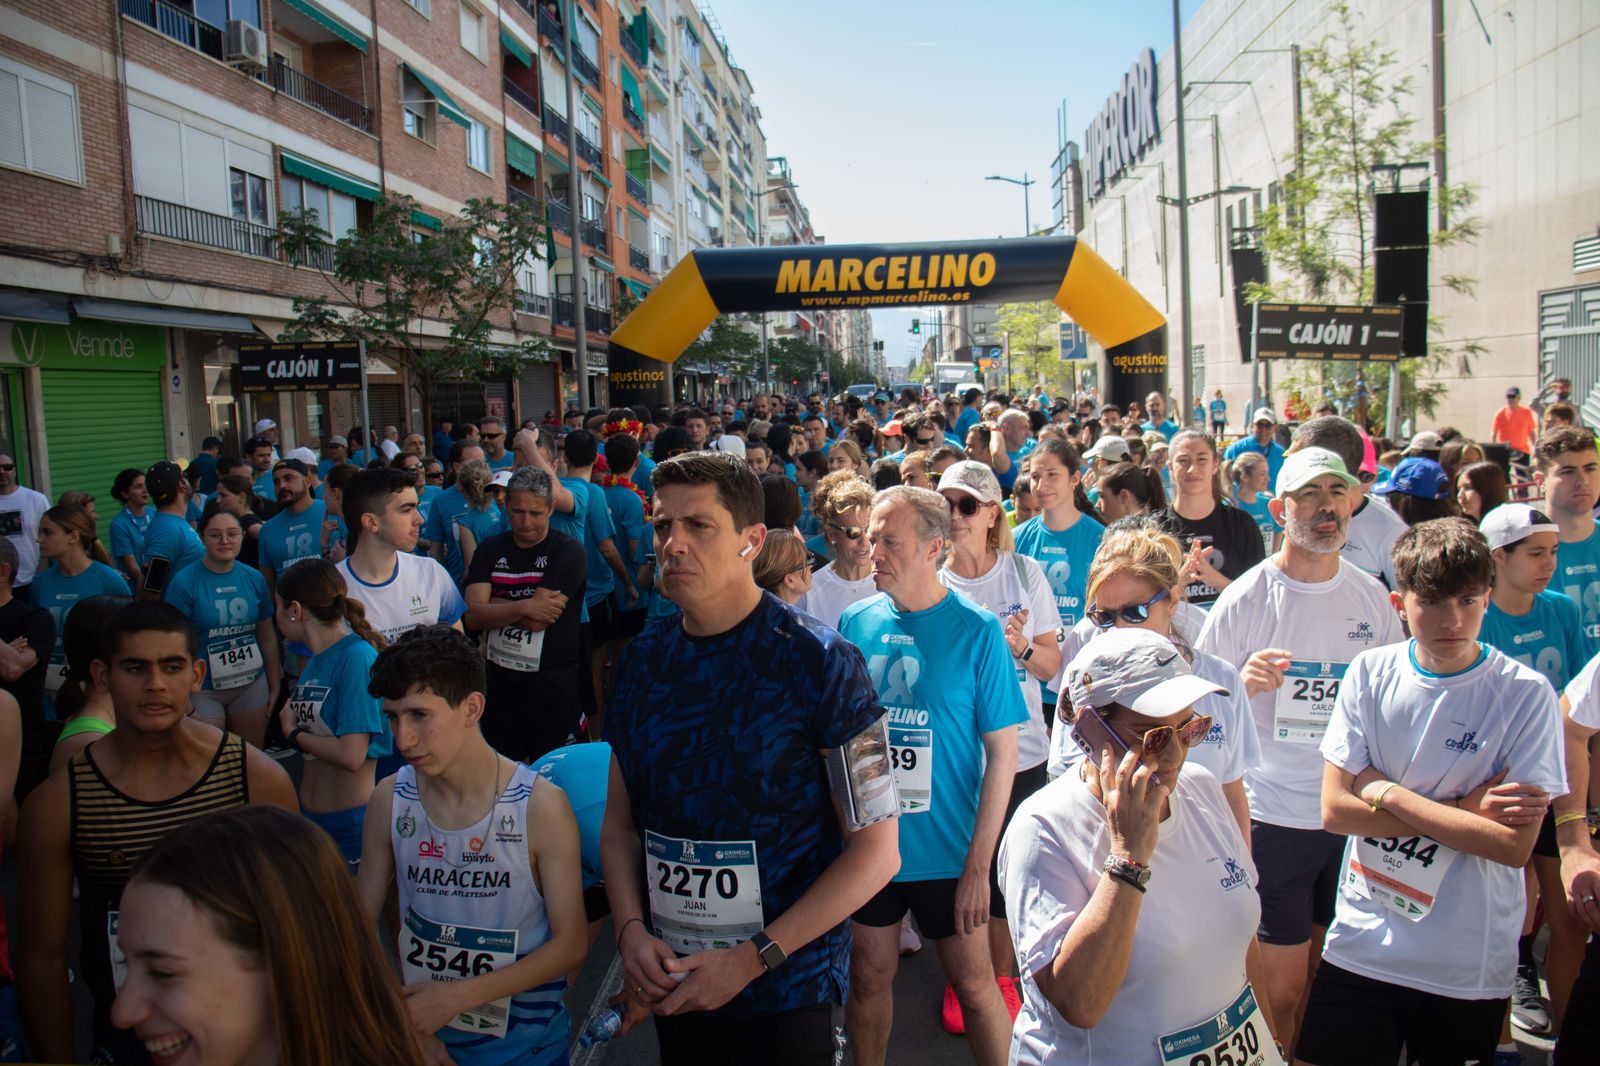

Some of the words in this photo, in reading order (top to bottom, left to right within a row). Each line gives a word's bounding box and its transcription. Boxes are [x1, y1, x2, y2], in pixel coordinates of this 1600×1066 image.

[775, 252, 997, 293] MARCELINO
[801, 291, 971, 307] www.mpmarcelino.es
[1288, 318, 1353, 345] CAJÓN
[1360, 325, 1371, 346] 1
[65, 328, 135, 358] Vennde
[266, 355, 320, 379] CAJÓN
[326, 359, 334, 377] 1
[610, 369, 665, 383] agustinos
[215, 597, 249, 625] 18
[208, 624, 255, 638] MARCELINO
[219, 646, 253, 665] 1841
[868, 655, 920, 704] 18
[1292, 679, 1340, 701] 254
[883, 706, 929, 727] ELINO
[1382, 854, 1403, 868] GALO
[407, 865, 511, 888] MARACENA
[658, 862, 739, 899] 2270
[416, 887, 437, 895] CLUB
[451, 890, 498, 898] ATLETISMO
[684, 900, 706, 911] JUAN
[440, 925, 456, 937] 18
[407, 936, 494, 977] 2546
[431, 974, 460, 982] MATE
[1216, 1012, 1229, 1031] 18
[1173, 1035, 1201, 1047] OXIMESA
